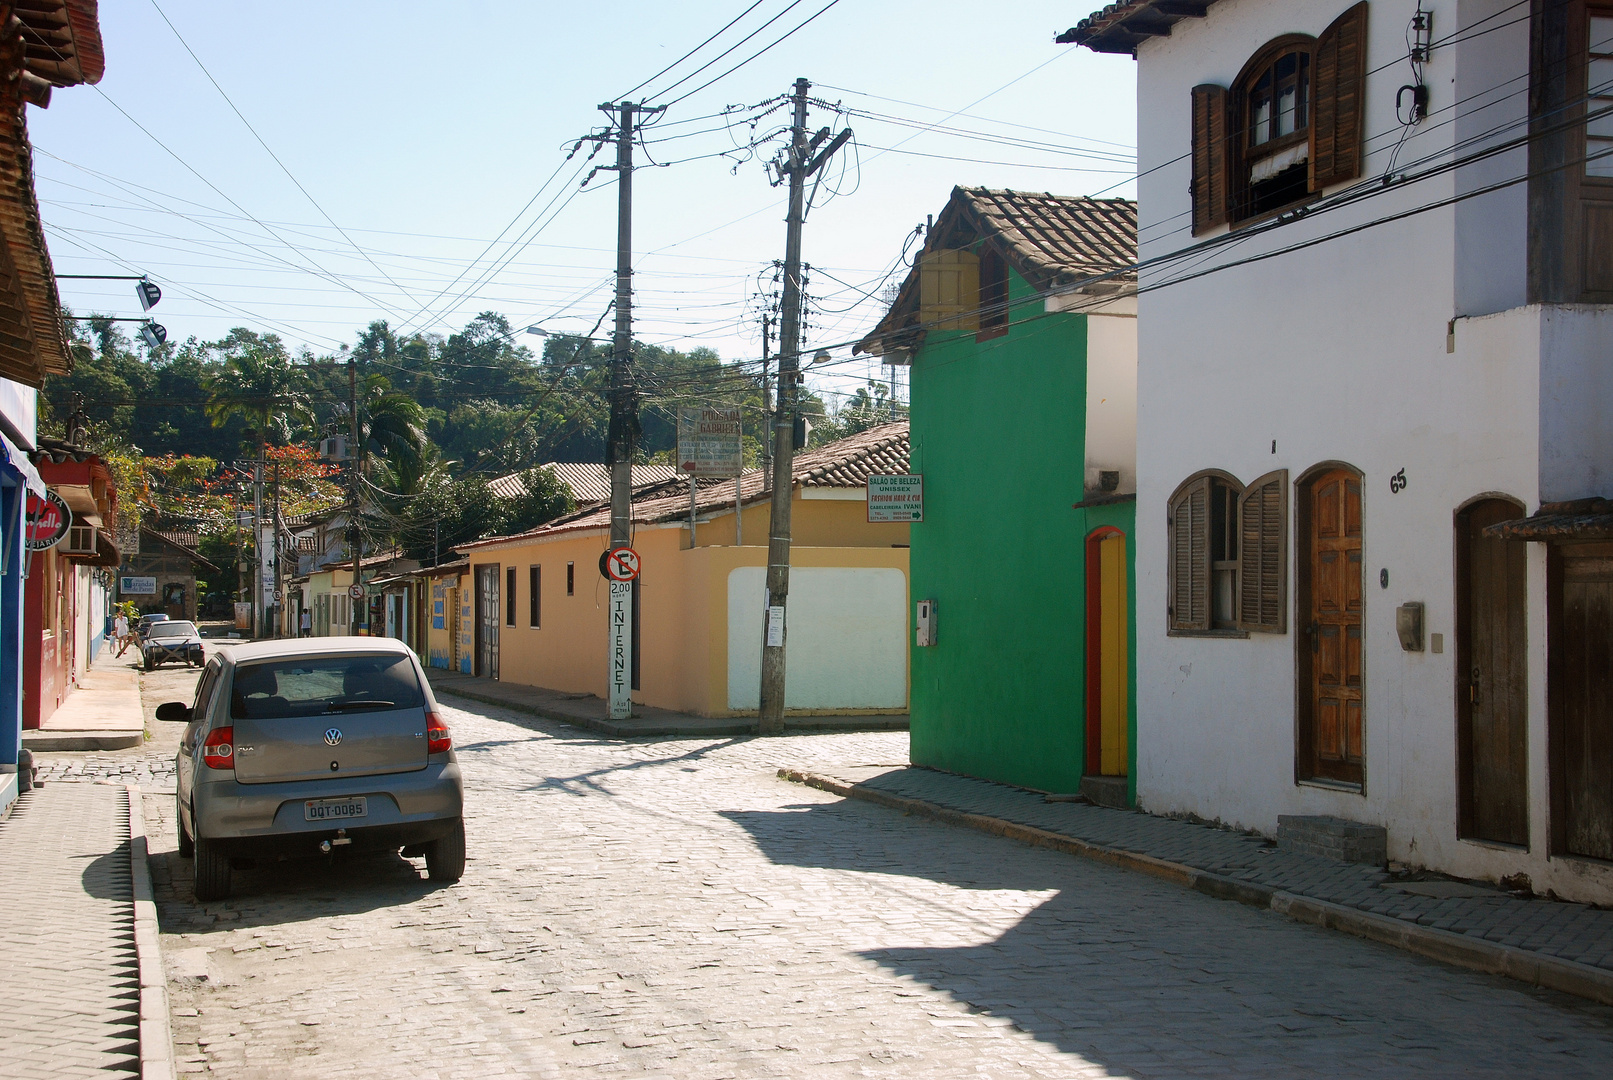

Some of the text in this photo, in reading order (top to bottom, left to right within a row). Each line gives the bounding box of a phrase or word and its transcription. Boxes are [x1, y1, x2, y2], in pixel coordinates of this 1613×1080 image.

[870, 477, 889, 485] SALÃO
[1389, 466, 1407, 494] 65
[614, 600, 625, 694] INTERNET
